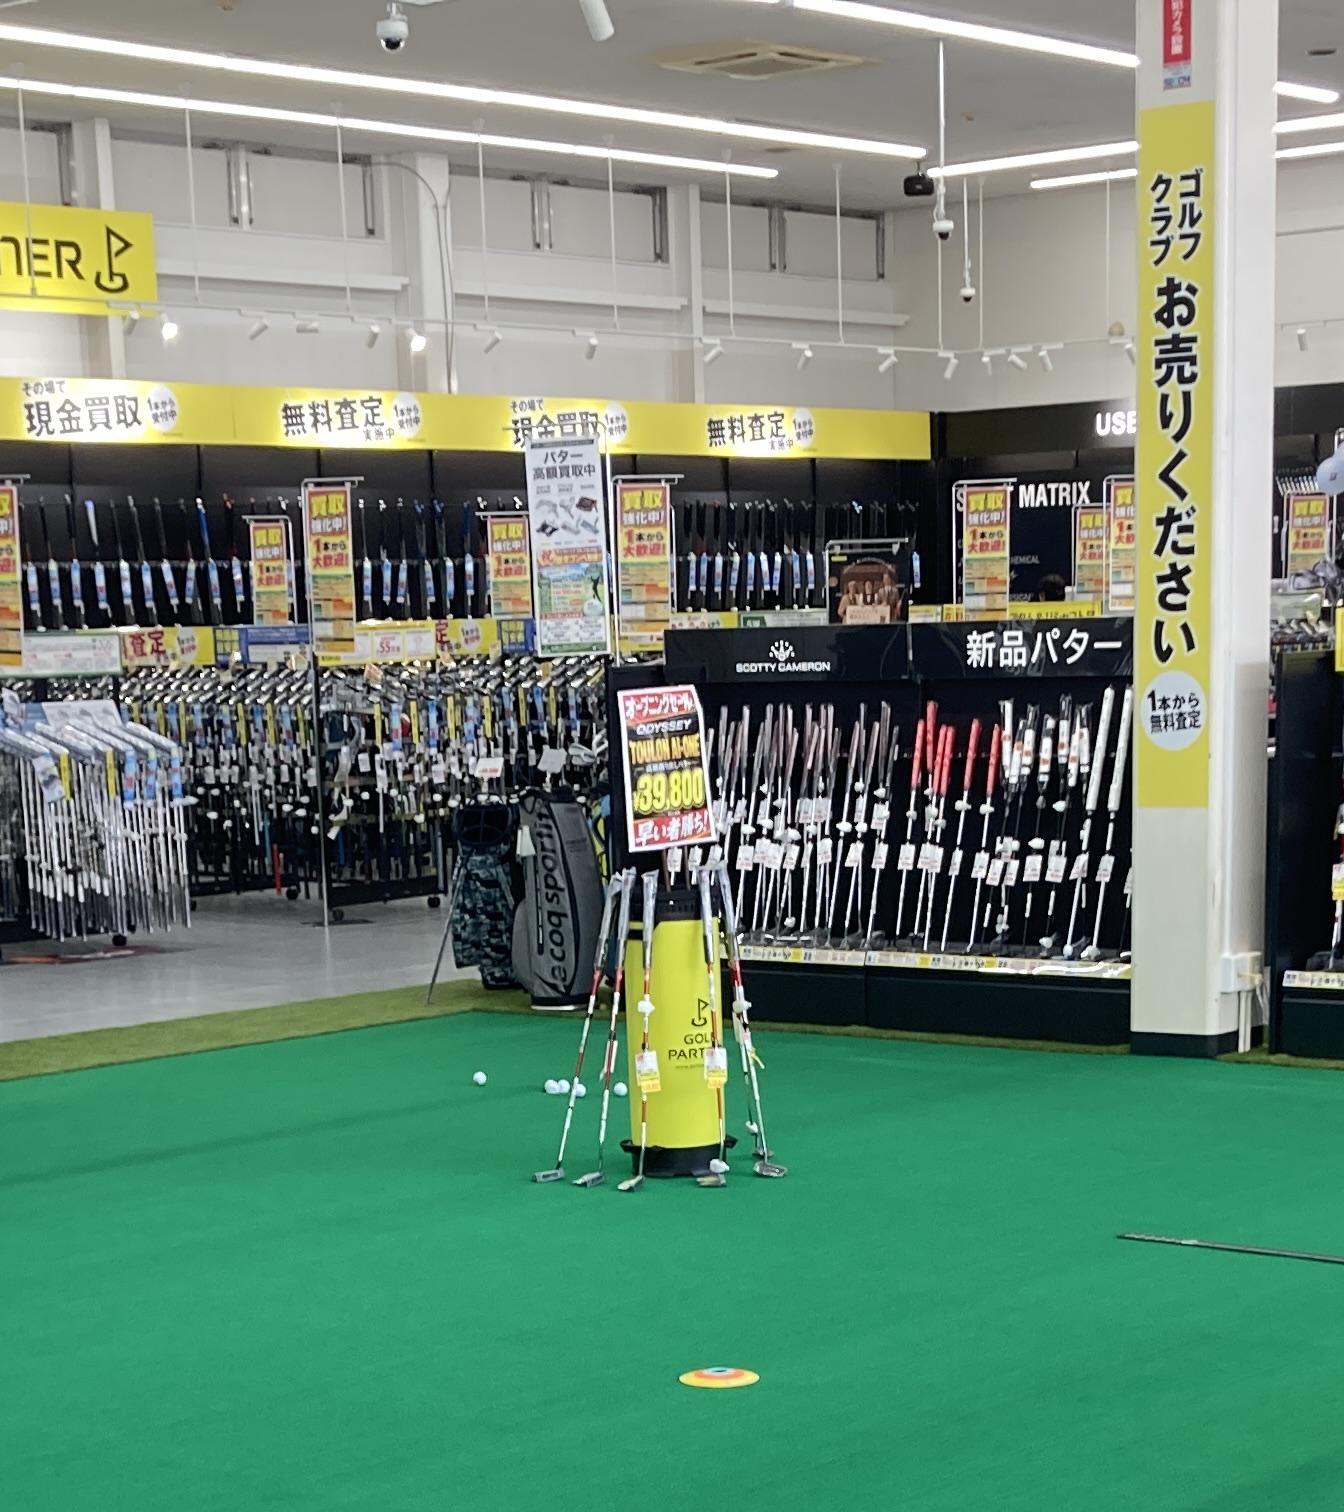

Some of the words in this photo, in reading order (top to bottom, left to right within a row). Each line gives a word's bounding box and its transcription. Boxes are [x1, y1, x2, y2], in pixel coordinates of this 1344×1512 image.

[1150, 174, 1176, 266] クラブ
[1178, 169, 1203, 261] ゴルフ
[25, 395, 141, 436] 現金買取
[282, 397, 385, 436] 無料査定
[708, 412, 786, 445] 無料査定
[1152, 275, 1199, 664] お売りください
[1018, 482, 1091, 508] MATRIX
[966, 628, 1122, 668] 新品パター
[736, 662, 776, 673] SCOTTY
[778, 661, 831, 672] CAMERON
[624, 692, 693, 719] オープニングセール
[1146, 688, 1200, 712] 1本から
[636, 719, 692, 736] ODYSSEY
[1149, 710, 1201, 734] 無料査定
[629, 737, 670, 765] TOULON
[633, 768, 705, 813] ¥39,800
[636, 811, 709, 847] 早い者勝ち!
[668, 1048, 705, 1061] PART
[684, 1033, 710, 1046] GOL
